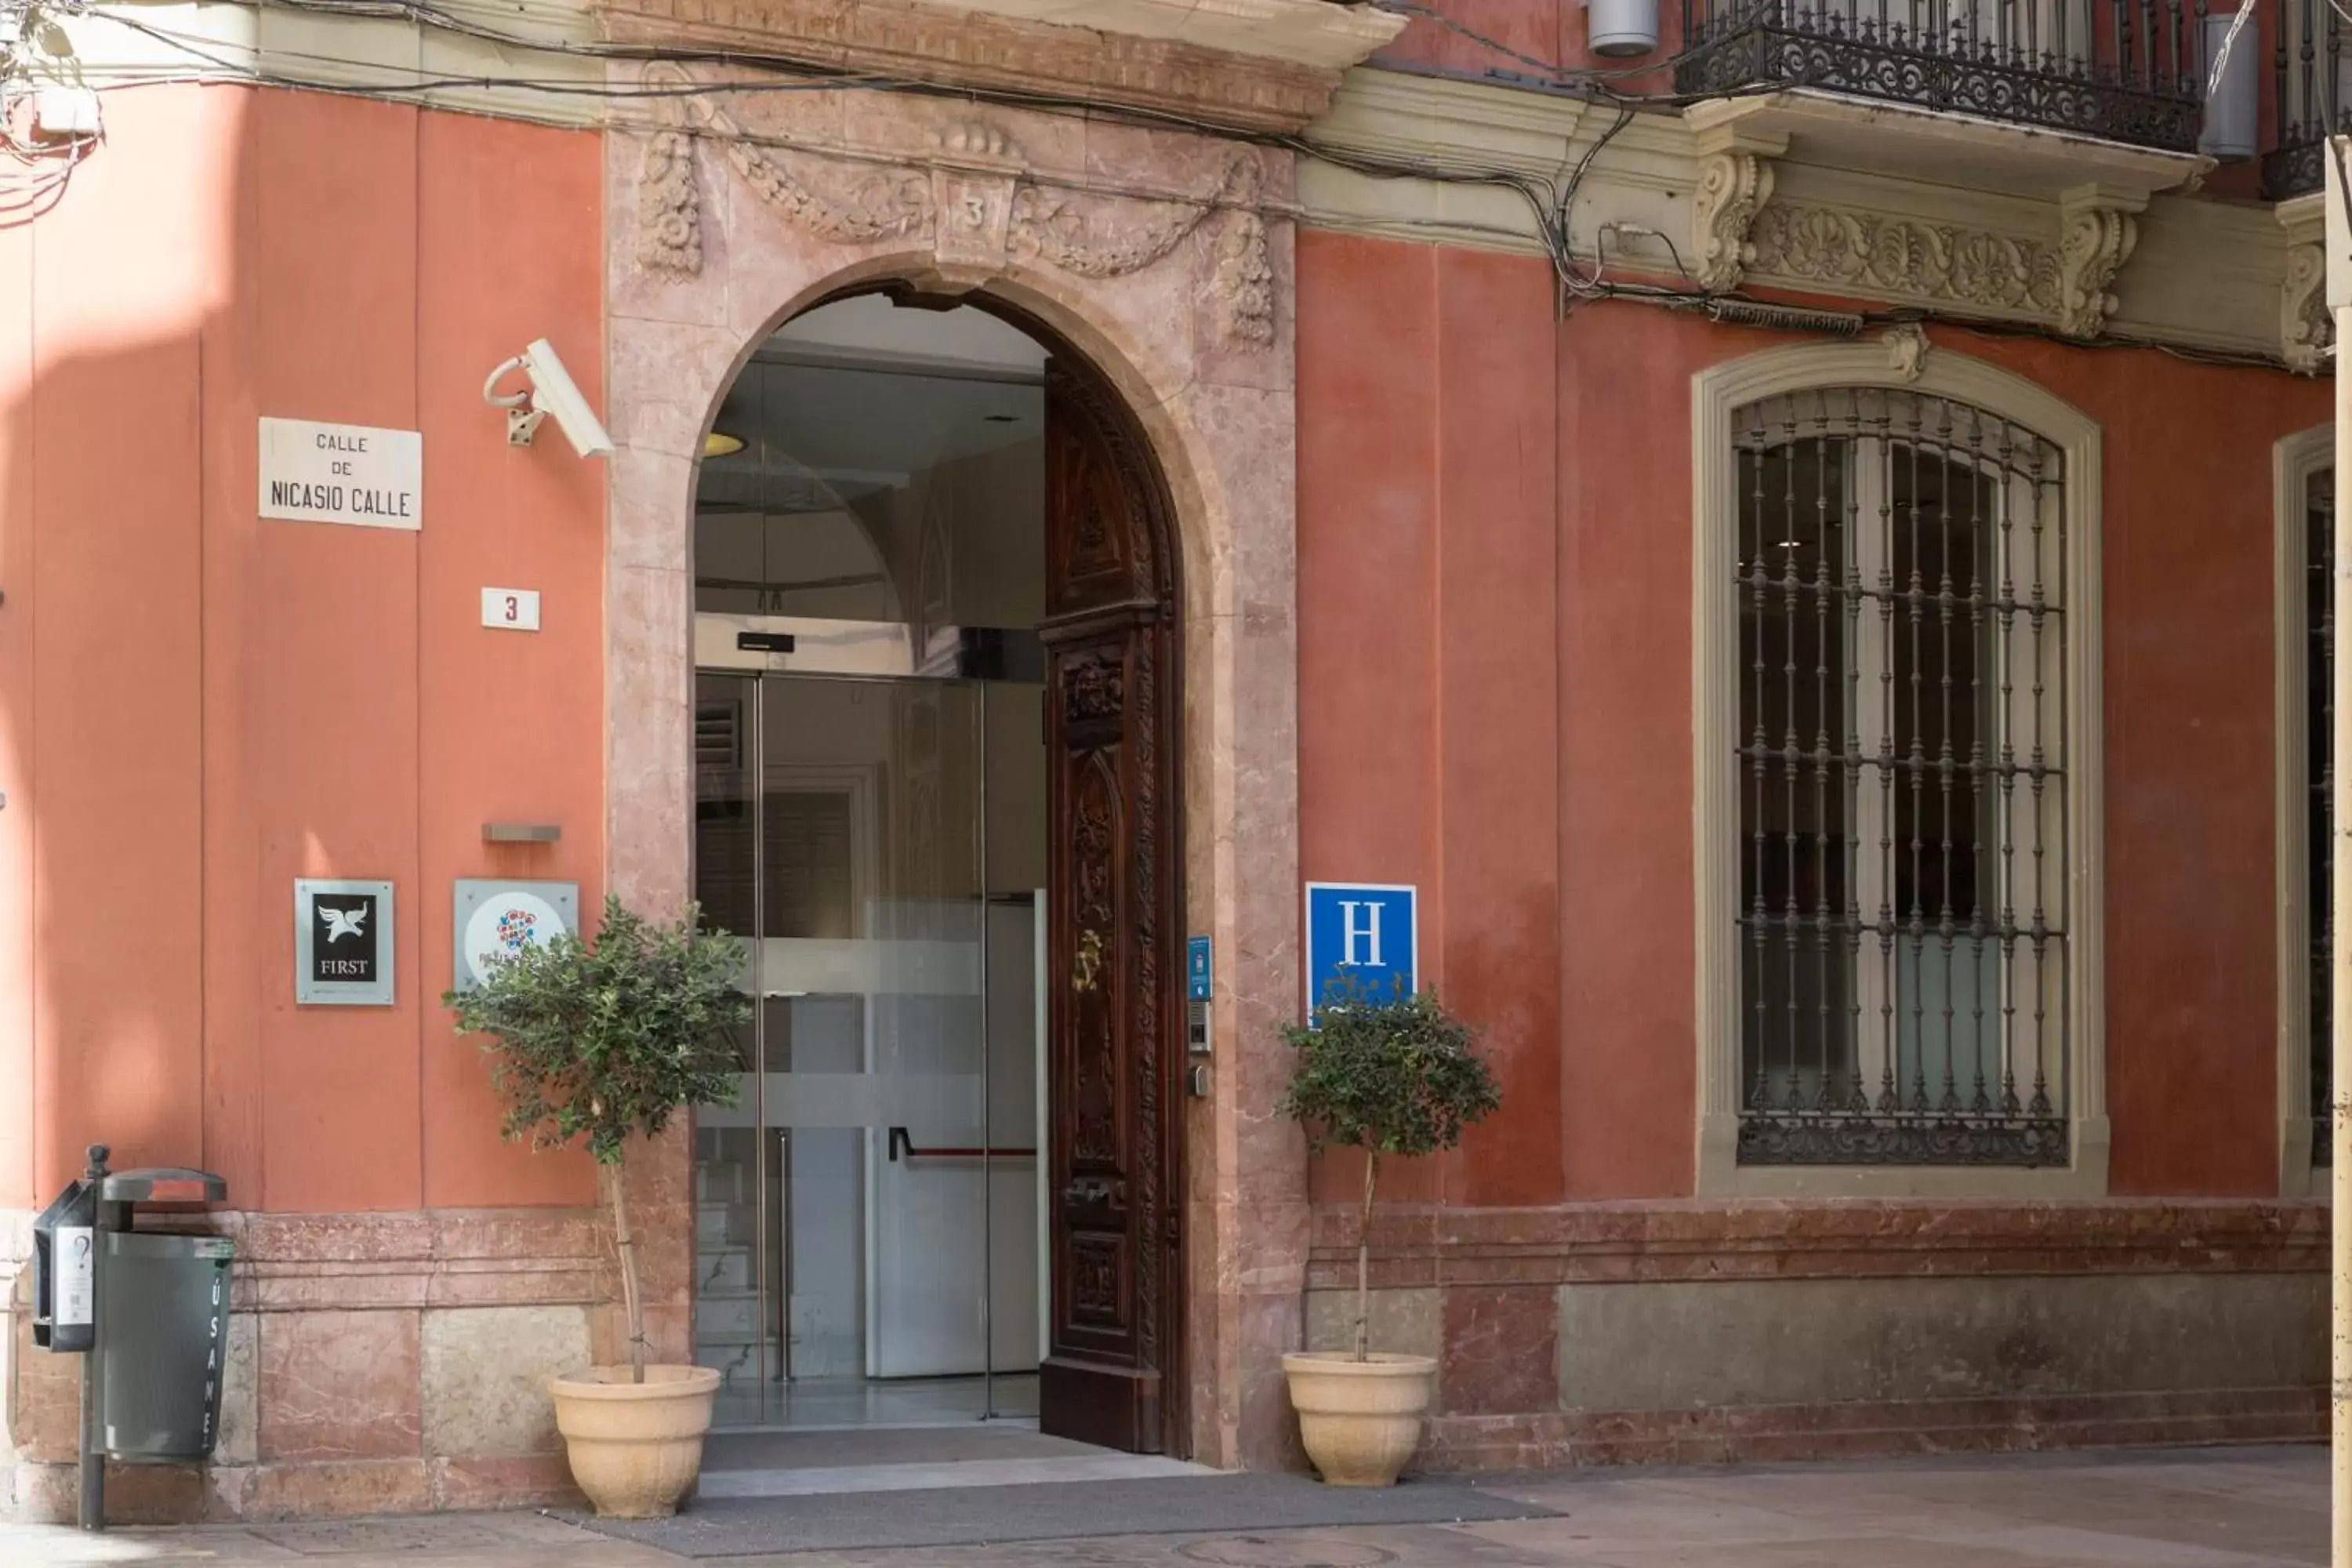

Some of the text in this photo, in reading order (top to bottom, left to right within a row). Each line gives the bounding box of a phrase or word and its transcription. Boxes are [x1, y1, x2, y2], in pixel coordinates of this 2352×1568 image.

[316, 434, 368, 452] CALLE
[332, 461, 352, 475] DE
[272, 481, 411, 517] NICASIO CALLE
[505, 596, 517, 621] 3
[1338, 901, 1386, 966] H
[321, 960, 368, 975] FIRST
